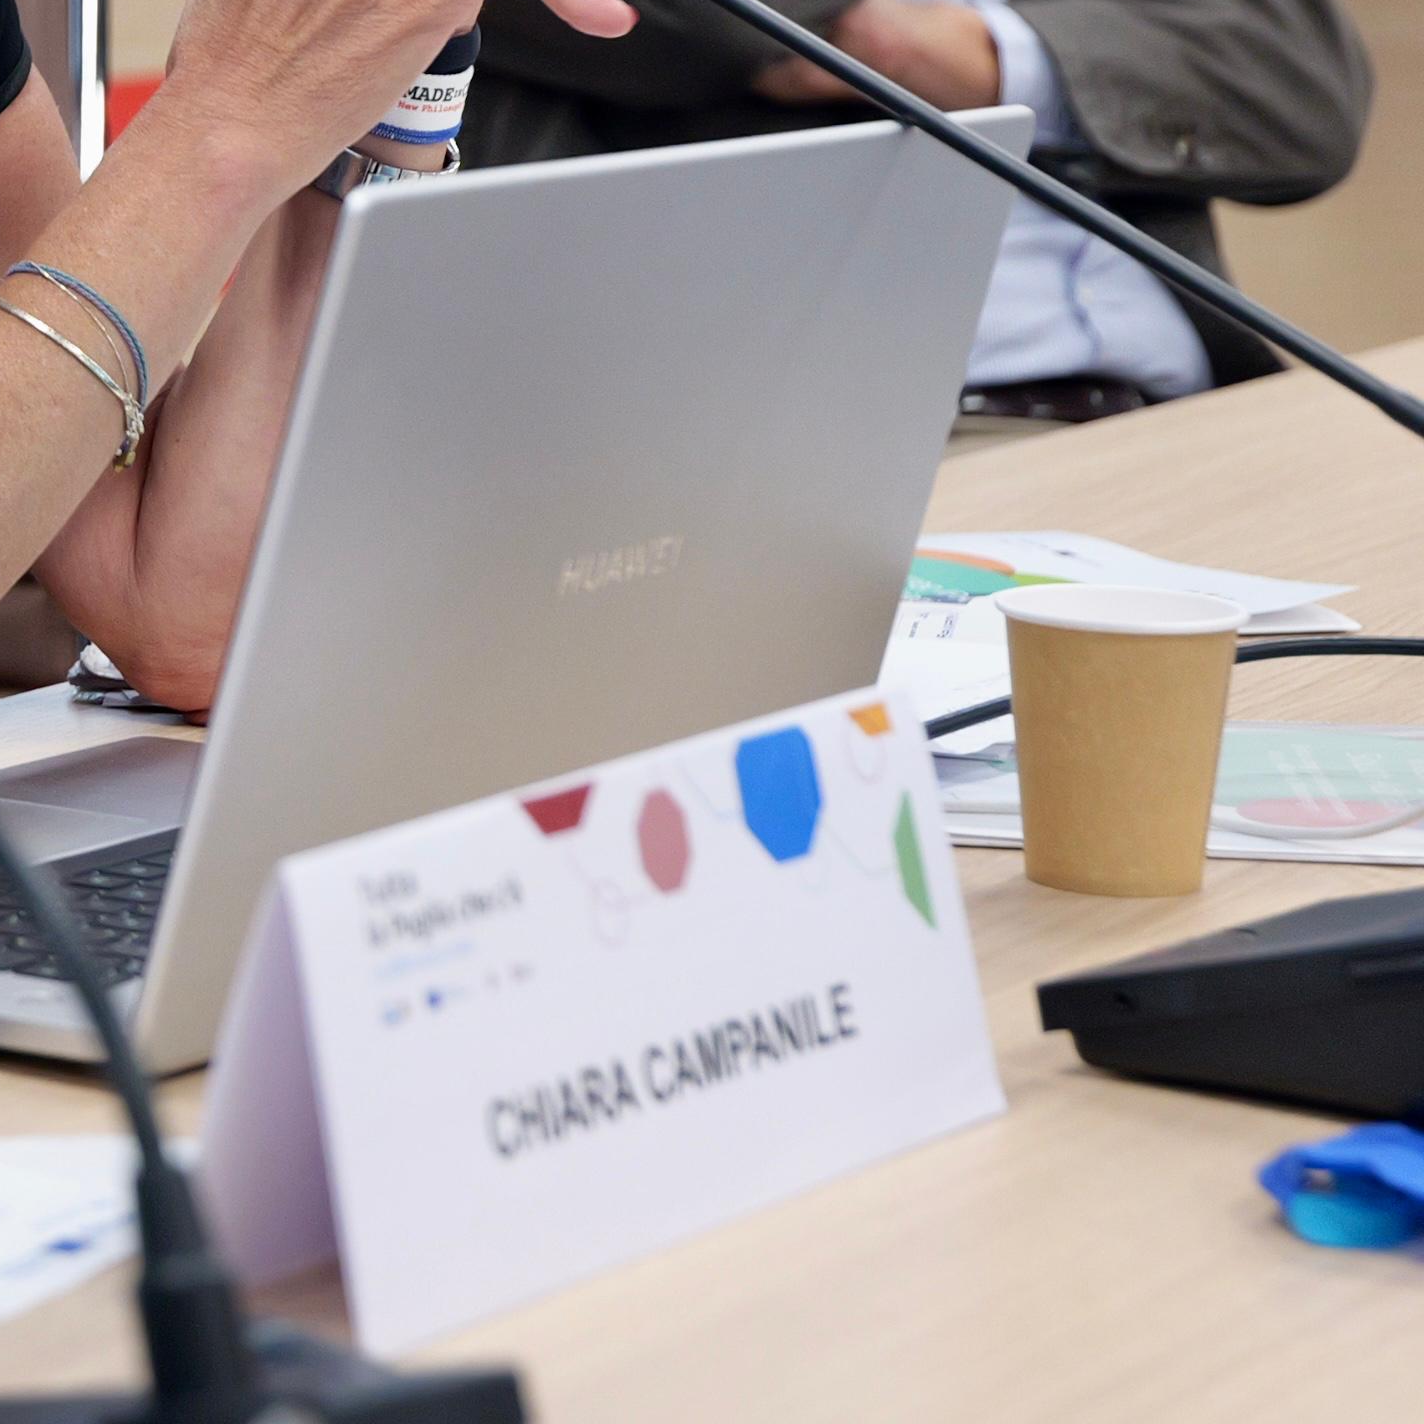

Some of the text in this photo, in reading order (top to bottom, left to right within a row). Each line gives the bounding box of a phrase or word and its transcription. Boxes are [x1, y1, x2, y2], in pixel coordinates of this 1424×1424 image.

[403, 85, 454, 102] MADE
[557, 533, 685, 597] HUAWEI
[486, 982, 860, 1161] CHIARA CAMPANILE
